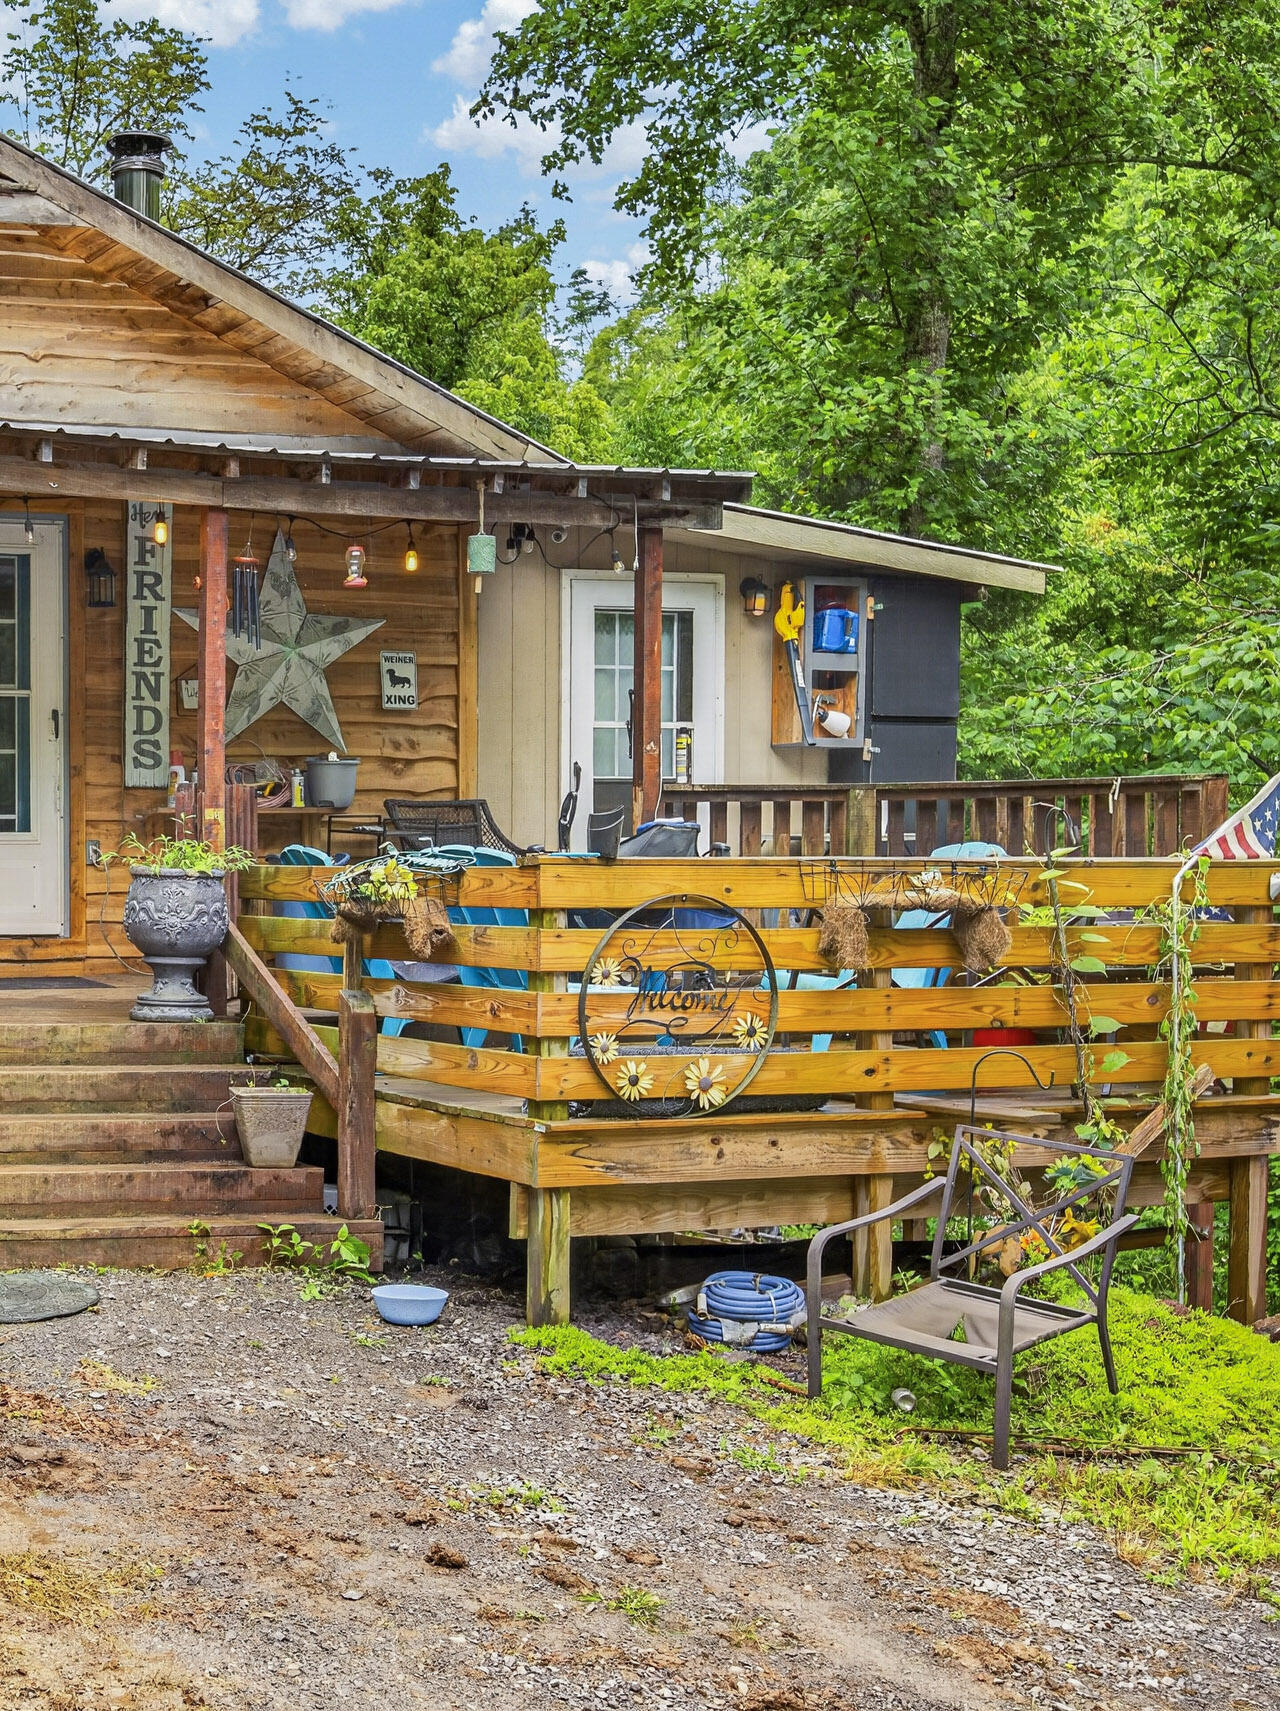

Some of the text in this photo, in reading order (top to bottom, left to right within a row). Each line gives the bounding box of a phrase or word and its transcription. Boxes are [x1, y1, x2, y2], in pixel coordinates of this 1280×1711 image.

[131, 535, 165, 770] FRIENDS
[383, 655, 414, 664] WEINER
[385, 694, 415, 705] XING
[619, 957, 730, 1018] Welcome
